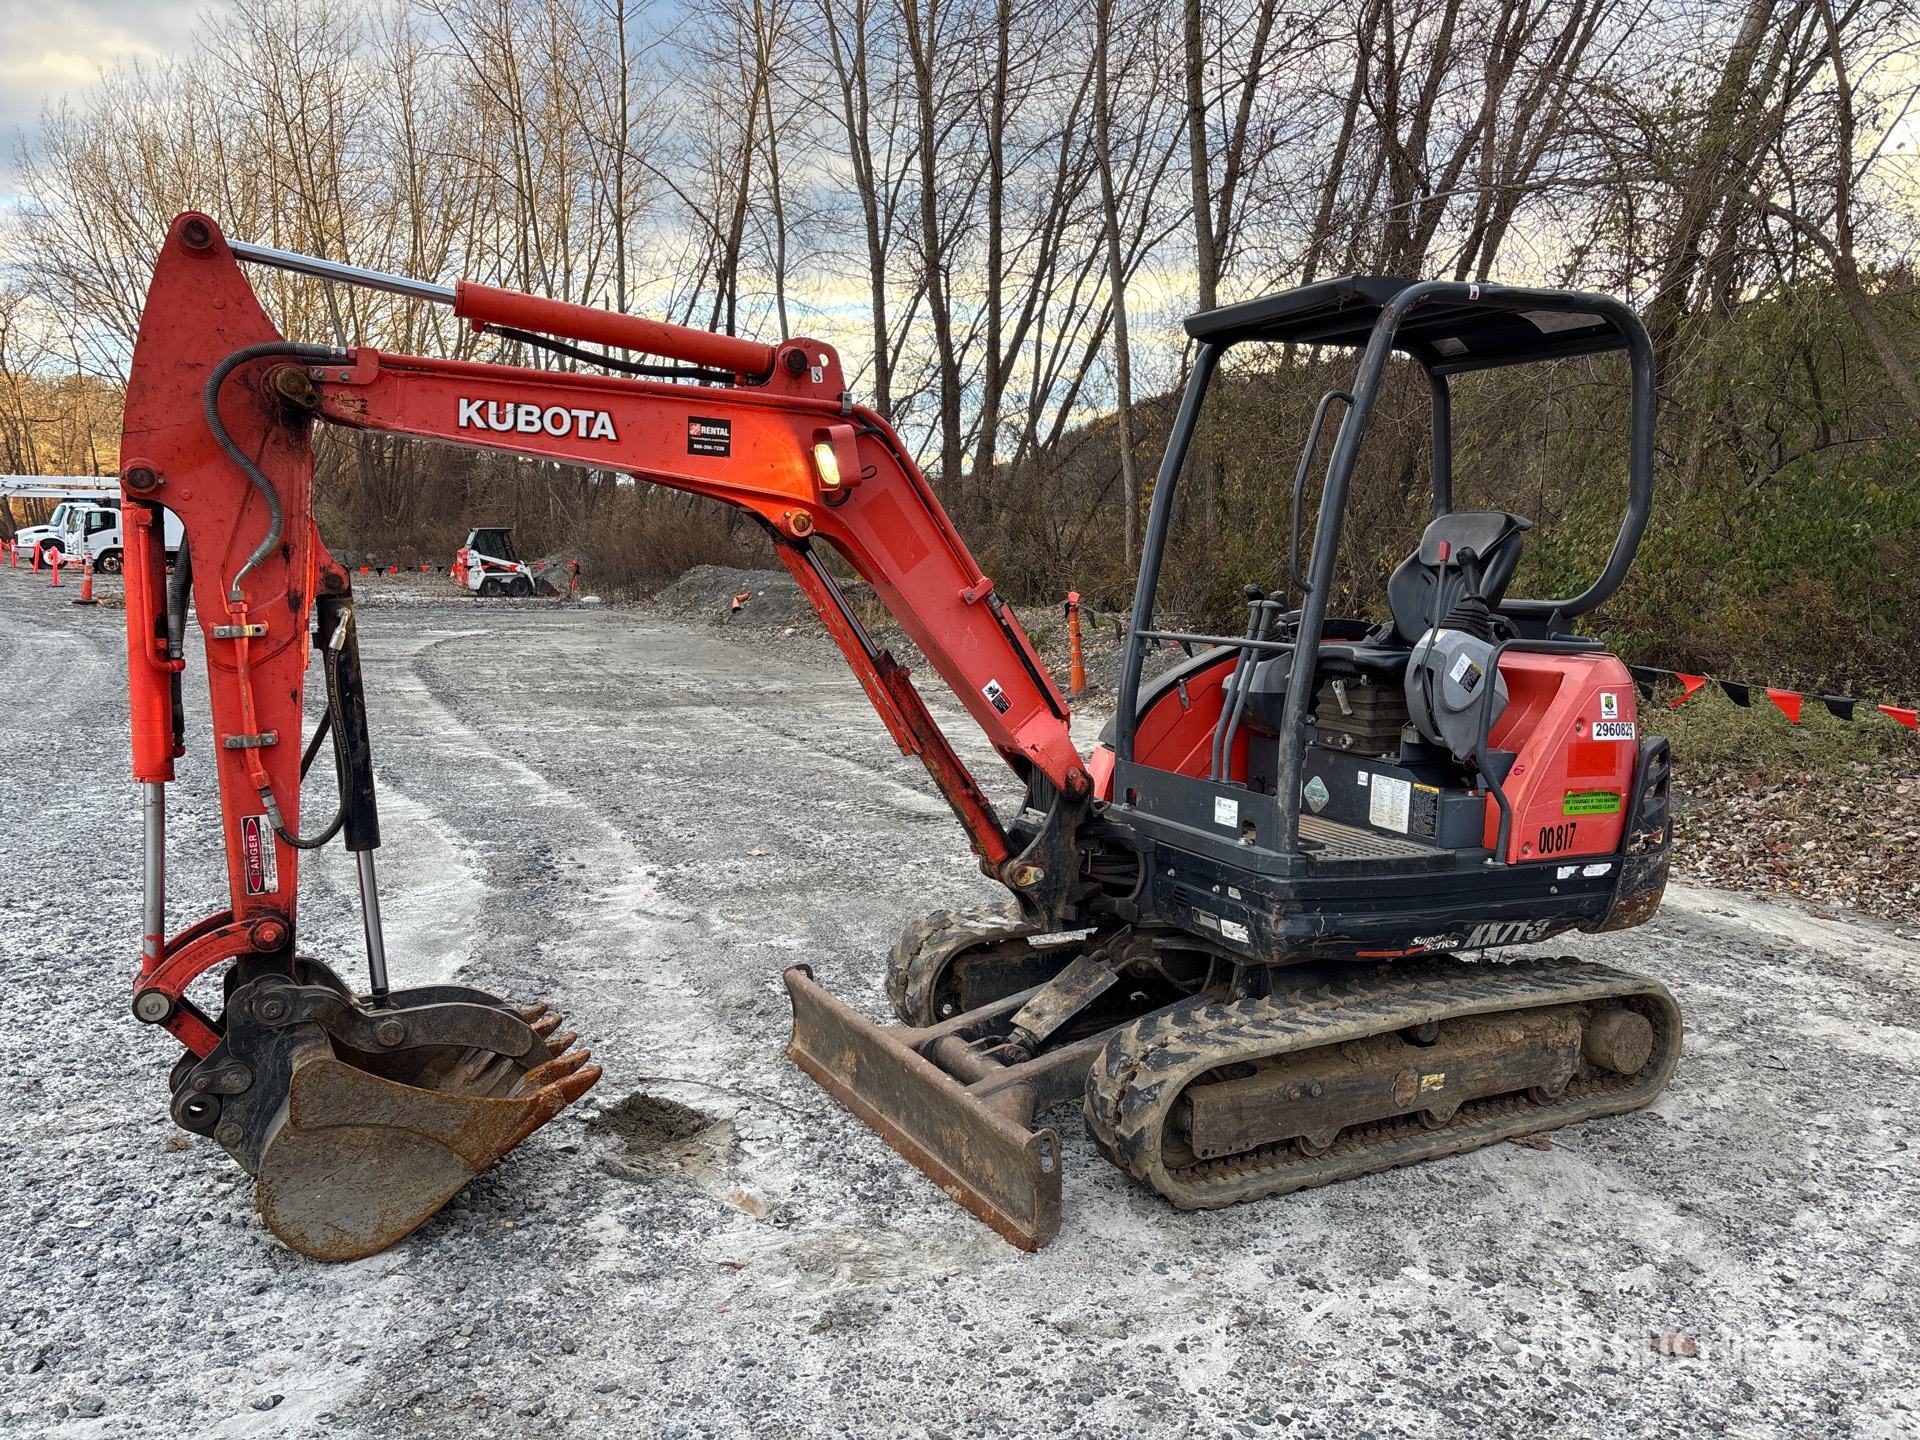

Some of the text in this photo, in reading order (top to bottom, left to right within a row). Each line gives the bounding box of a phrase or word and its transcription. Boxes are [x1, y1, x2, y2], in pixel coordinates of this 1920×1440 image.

[458, 398, 617, 441] KUBOTA
[701, 426, 730, 437] RENTAL
[1595, 723, 1633, 737] 2960825
[1539, 822, 1577, 854] 00817
[249, 835, 259, 876] DANGER
[1410, 933, 1446, 947] Super
[1463, 919, 1550, 948] KX71-3
